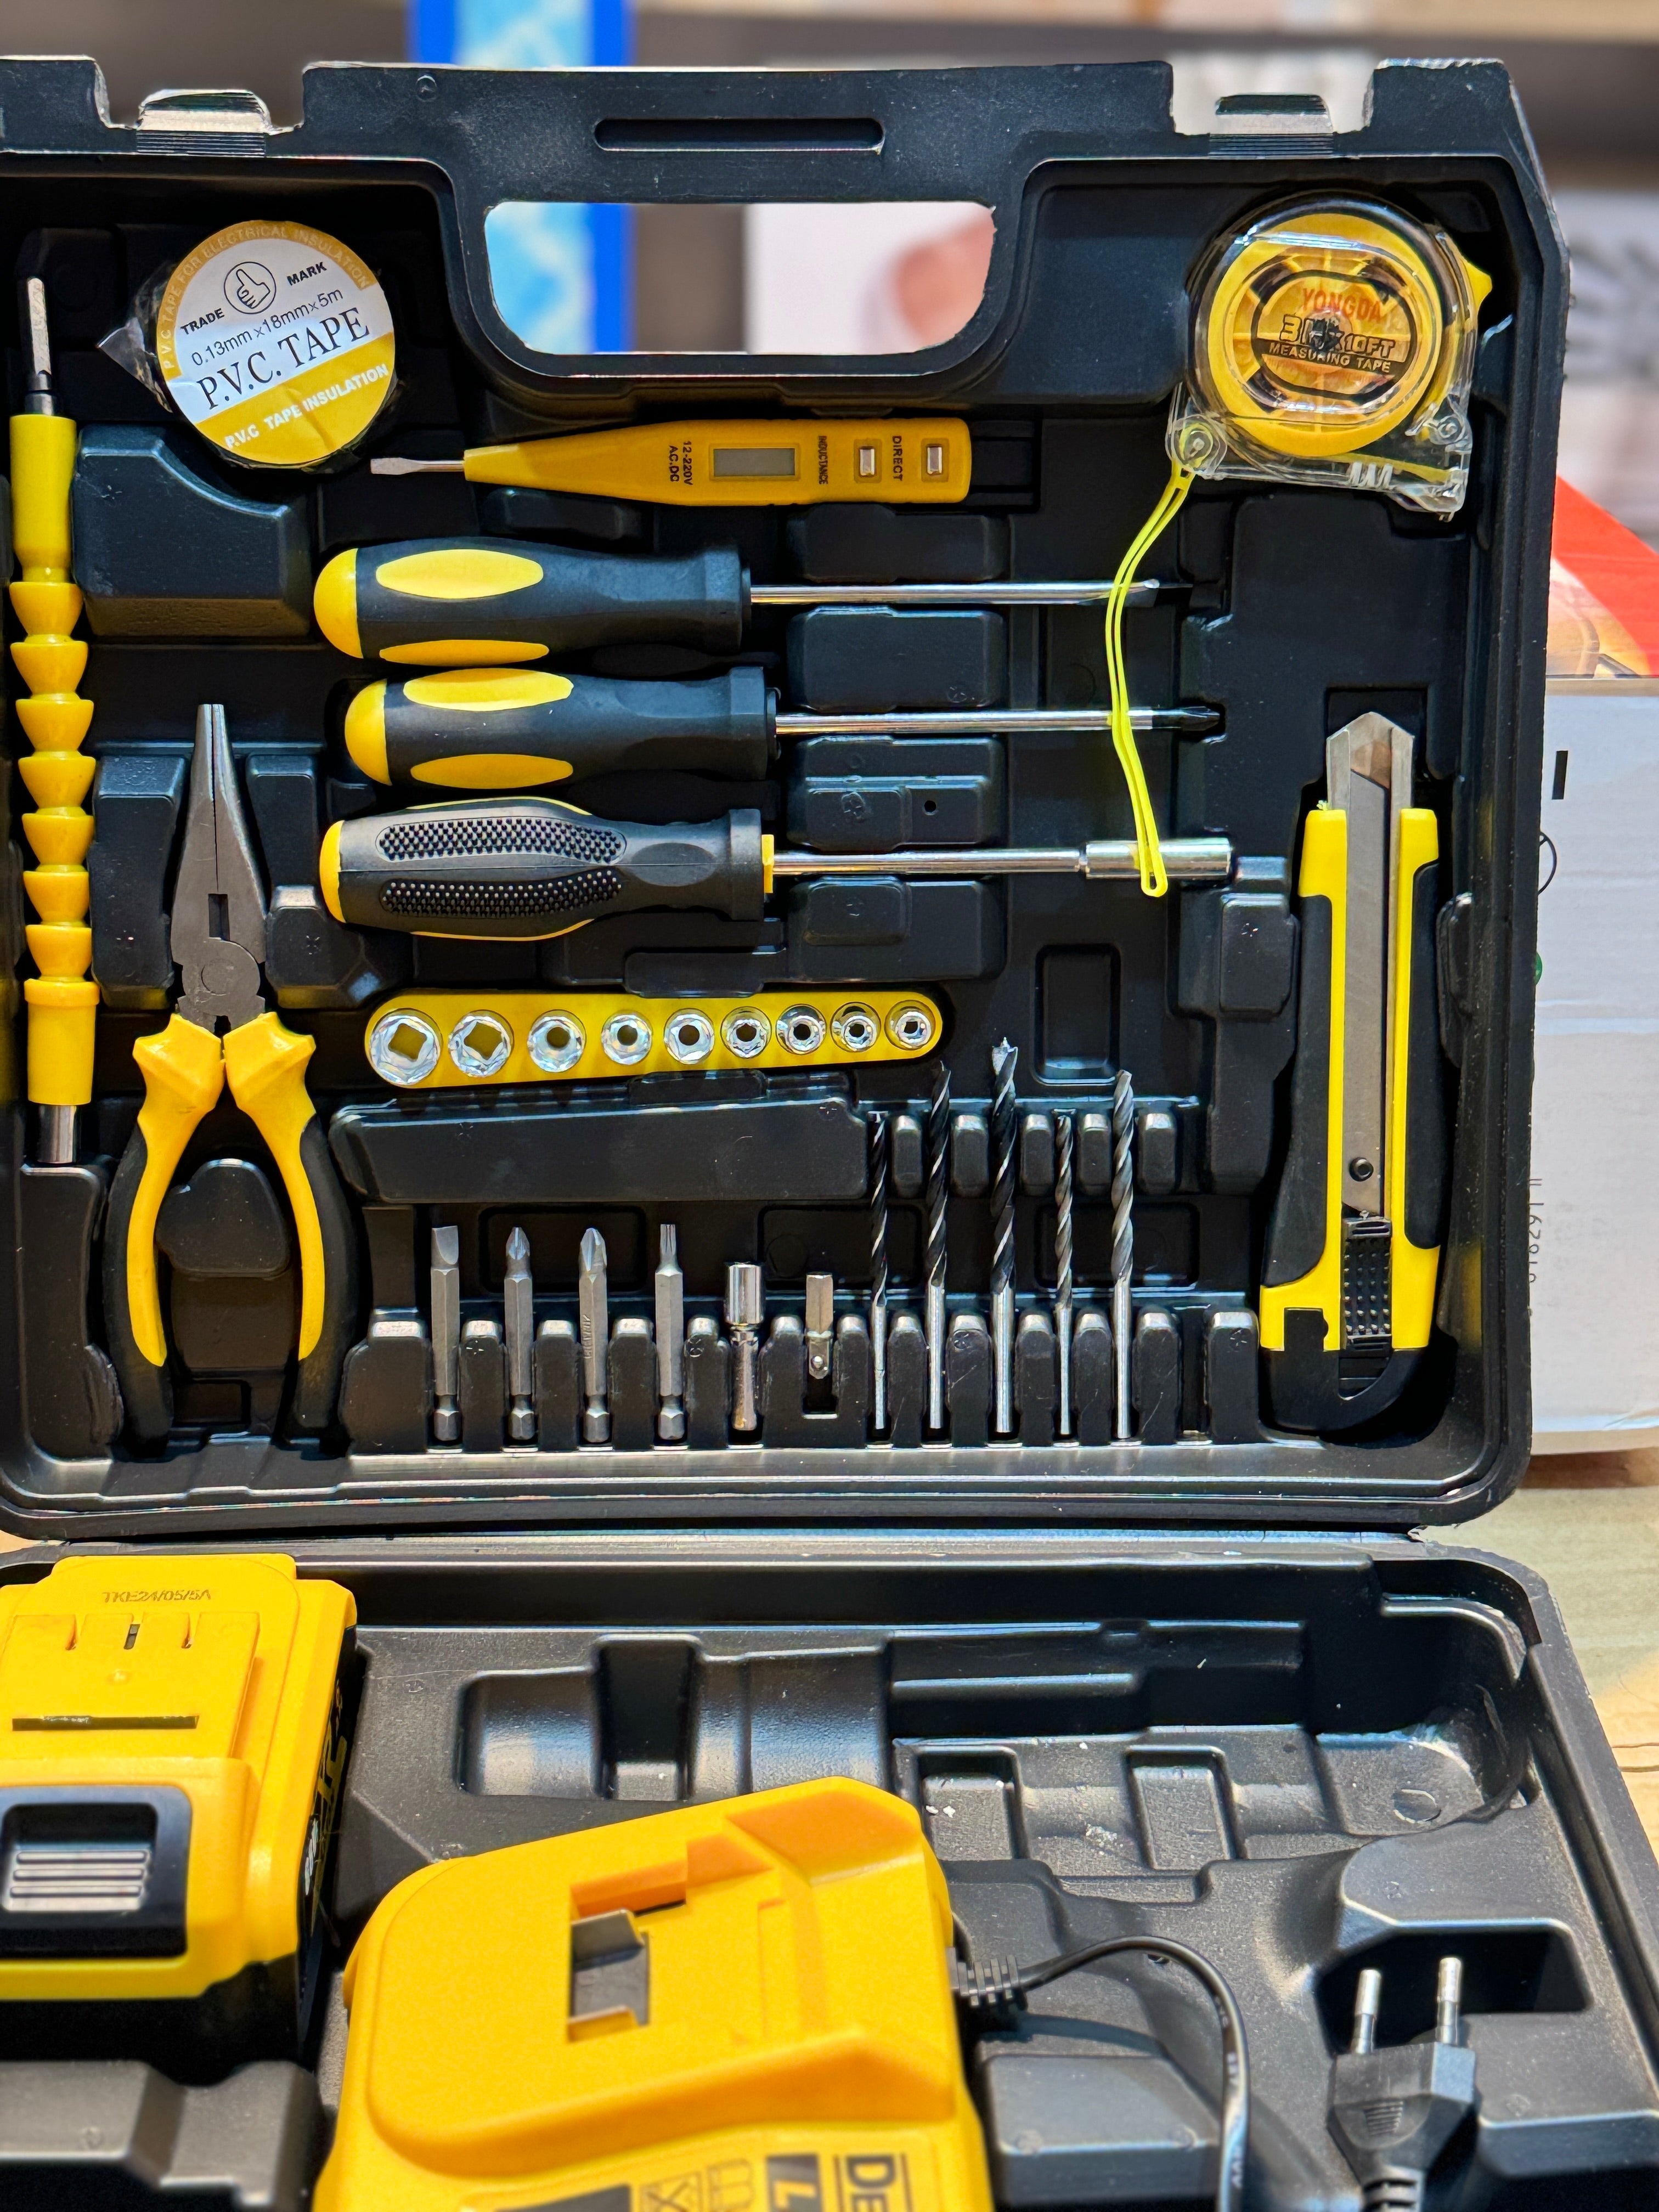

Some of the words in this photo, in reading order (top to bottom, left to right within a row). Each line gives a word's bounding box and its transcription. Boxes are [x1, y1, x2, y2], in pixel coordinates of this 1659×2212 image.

[163, 286, 181, 323] TAPE
[179, 257, 203, 284] FOR
[203, 225, 287, 258] ELECTRICAL
[294, 228, 370, 289] INSULATION
[180, 308, 225, 335] TRADE
[286, 262, 328, 286] MARK
[1302, 287, 1382, 322] YONGDA
[196, 351, 281, 410] P.V.C.
[278, 307, 370, 368] TAPE
[1356, 357, 1391, 374] TAPE
[224, 424, 259, 449] P.V.C
[263, 404, 303, 430] TAPE
[302, 363, 389, 411] INSULATION
[682, 441, 694, 486] 12-220V
[818, 436, 828, 484] INDUCTANCE
[892, 436, 903, 481] DIRECT
